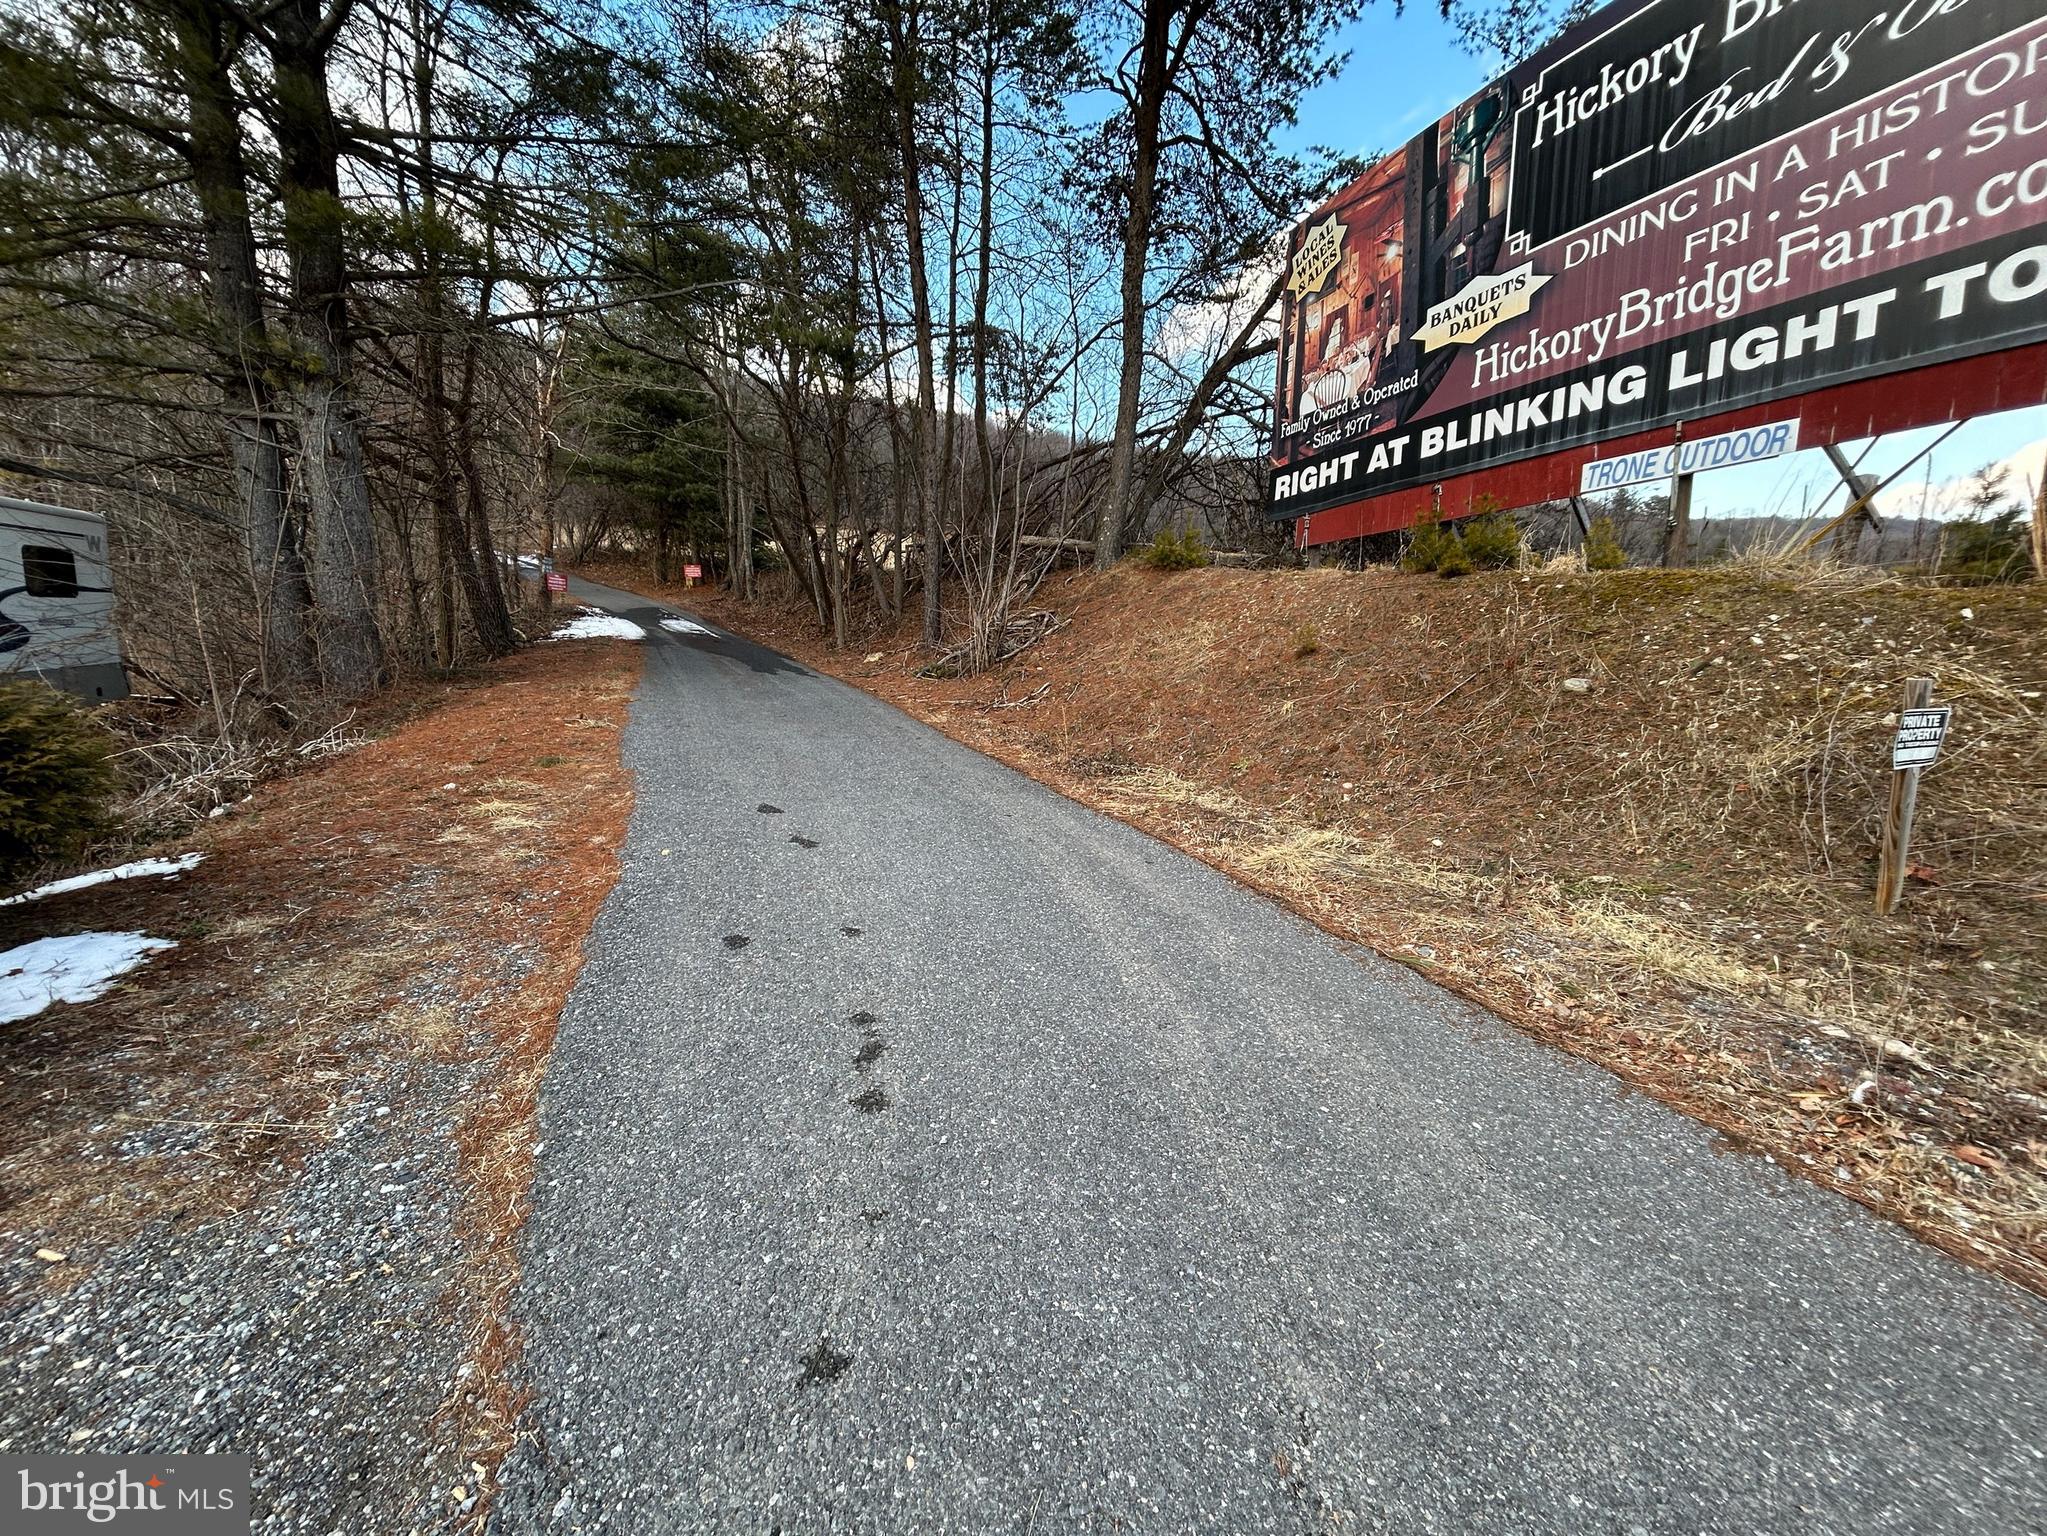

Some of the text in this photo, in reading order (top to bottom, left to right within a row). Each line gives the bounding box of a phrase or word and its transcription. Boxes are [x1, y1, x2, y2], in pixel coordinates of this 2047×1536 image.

[1531, 23, 1705, 149] Hickory
[1659, 12, 1888, 152] Bed &
[1564, 188, 1698, 270] DINING
[1712, 161, 1759, 207] IN
[1771, 143, 1810, 182] A
[1683, 211, 1750, 263] FRI
[1797, 149, 1906, 220] SAT
[1295, 224, 1334, 269] LOCAL
[1297, 235, 1336, 279] WINES
[1471, 158, 2047, 389] HickoryBridgeFarm.co
[1430, 273, 1527, 328] BANQUETS
[1449, 302, 1503, 338] DAILY
[1274, 245, 2047, 501] RIGHT AT BLINKING LIGHT TO
[1280, 369, 1419, 439] Family Owned & Operated
[1312, 428, 1342, 449] Since
[1345, 412, 1372, 438] 1977
[1587, 423, 1790, 489] TRONE OUTDOOR
[1898, 727, 1943, 742] PROPERTY
[1903, 715, 1942, 728] PRIVATE
